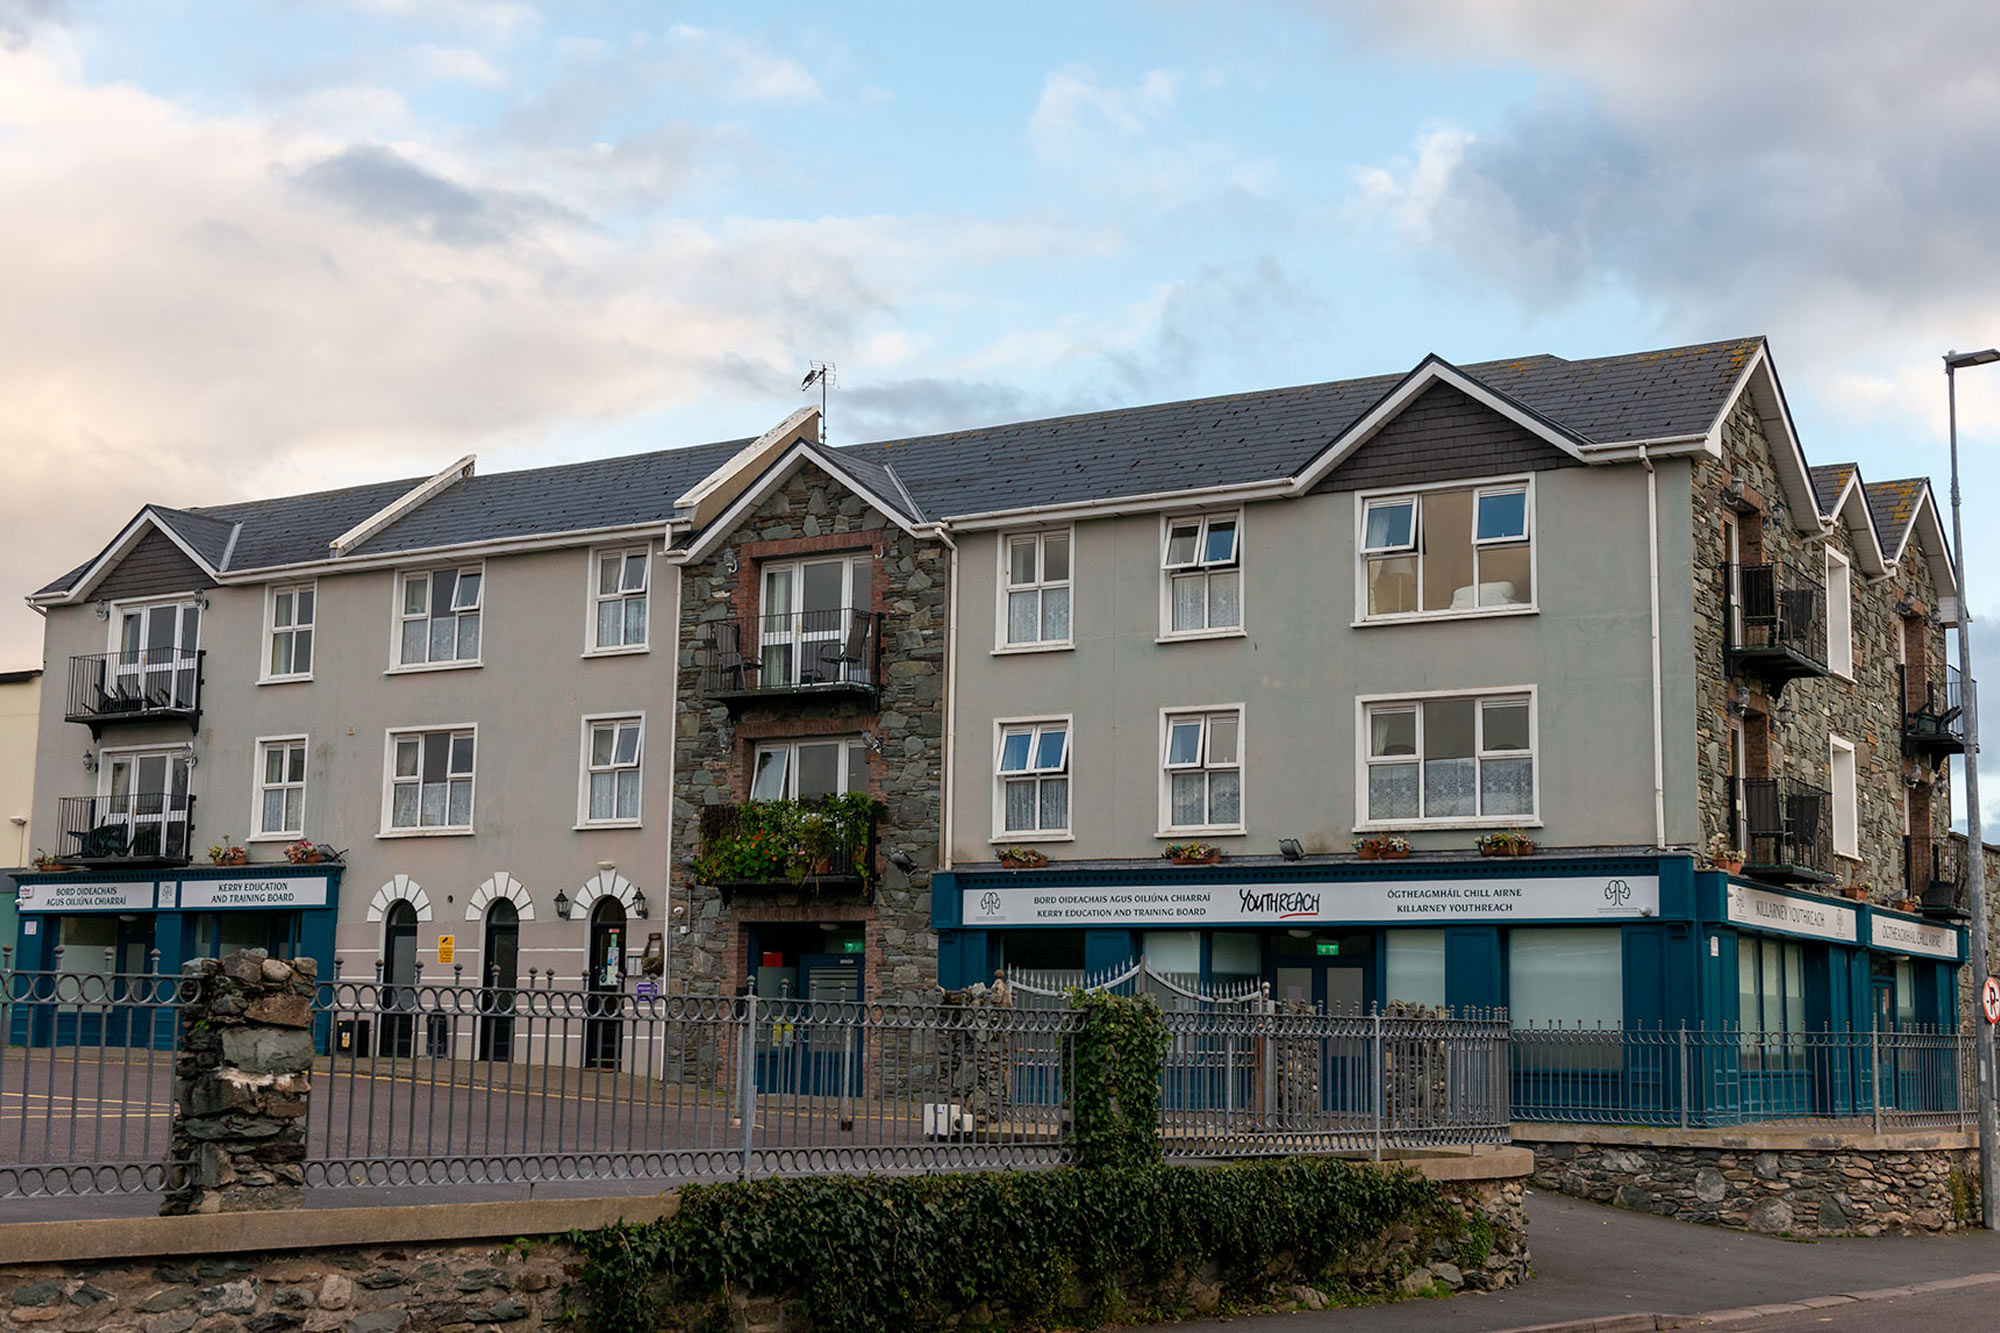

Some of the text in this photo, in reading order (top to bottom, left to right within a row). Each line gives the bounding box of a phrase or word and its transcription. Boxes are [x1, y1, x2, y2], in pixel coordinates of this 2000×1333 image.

[56, 886, 118, 896] BORD OIDEACHAIS
[218, 882, 288, 892] KERRY EDUCATION
[1387, 887, 1523, 898] ÓGTHEAGMHÁIL CHILL AIRNE
[46, 897, 65, 906] AGUS
[211, 893, 295, 903] AND TRAINING BOARD
[1033, 892, 1211, 904] BORD OIDEACHAIS AGUS OILIÚNA CHIARRAÍ
[1239, 888, 1321, 913] YOUTHREACH
[1037, 908, 1207, 917] KERRY EDUCATION AND TRAINING BOARD
[1397, 903, 1513, 912] KILLARNEY YOUTHREACH
[1756, 900, 1788, 920] KILLARNEY
